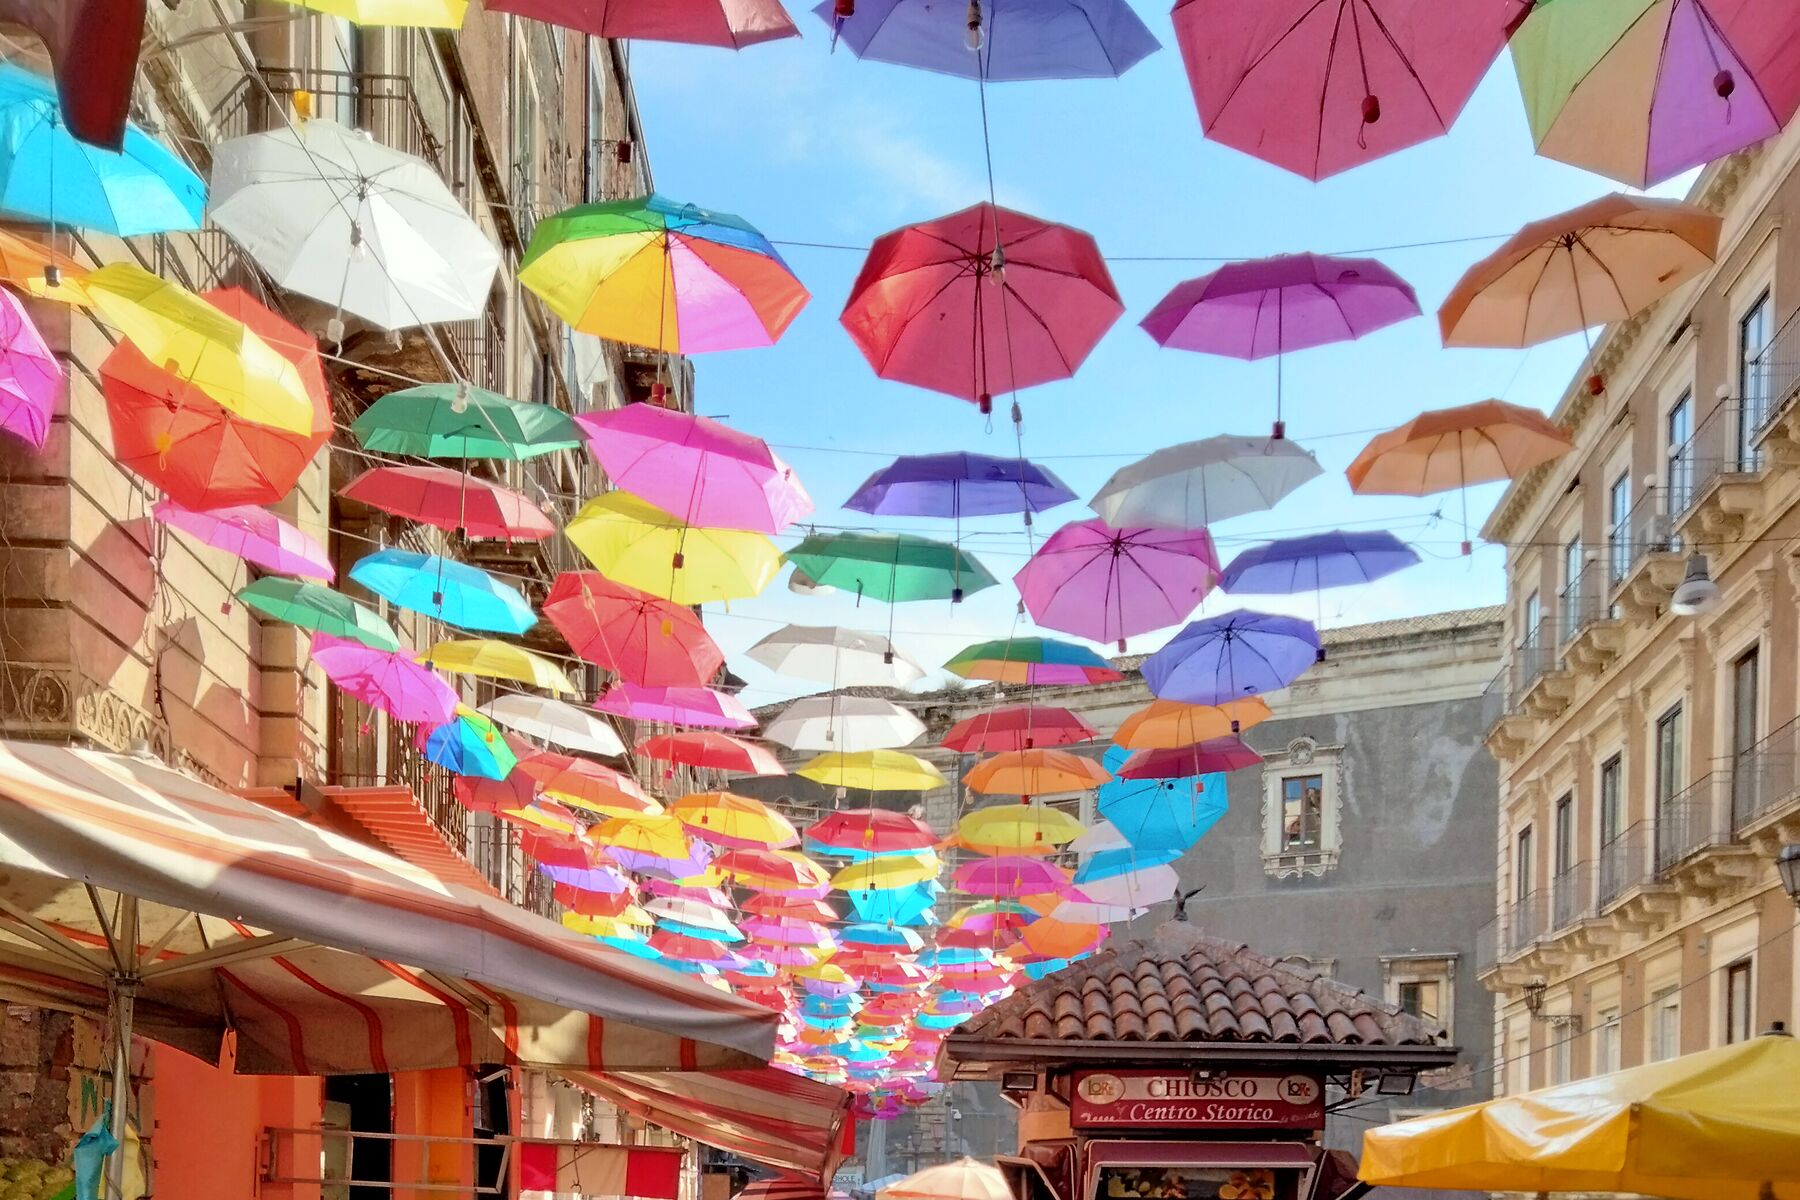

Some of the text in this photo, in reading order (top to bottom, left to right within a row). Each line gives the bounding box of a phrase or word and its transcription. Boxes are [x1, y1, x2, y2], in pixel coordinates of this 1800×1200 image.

[1147, 1079, 1258, 1097] CHIOSCO
[1129, 1103, 1197, 1121] Centro
[1201, 1103, 1274, 1121] Storico
